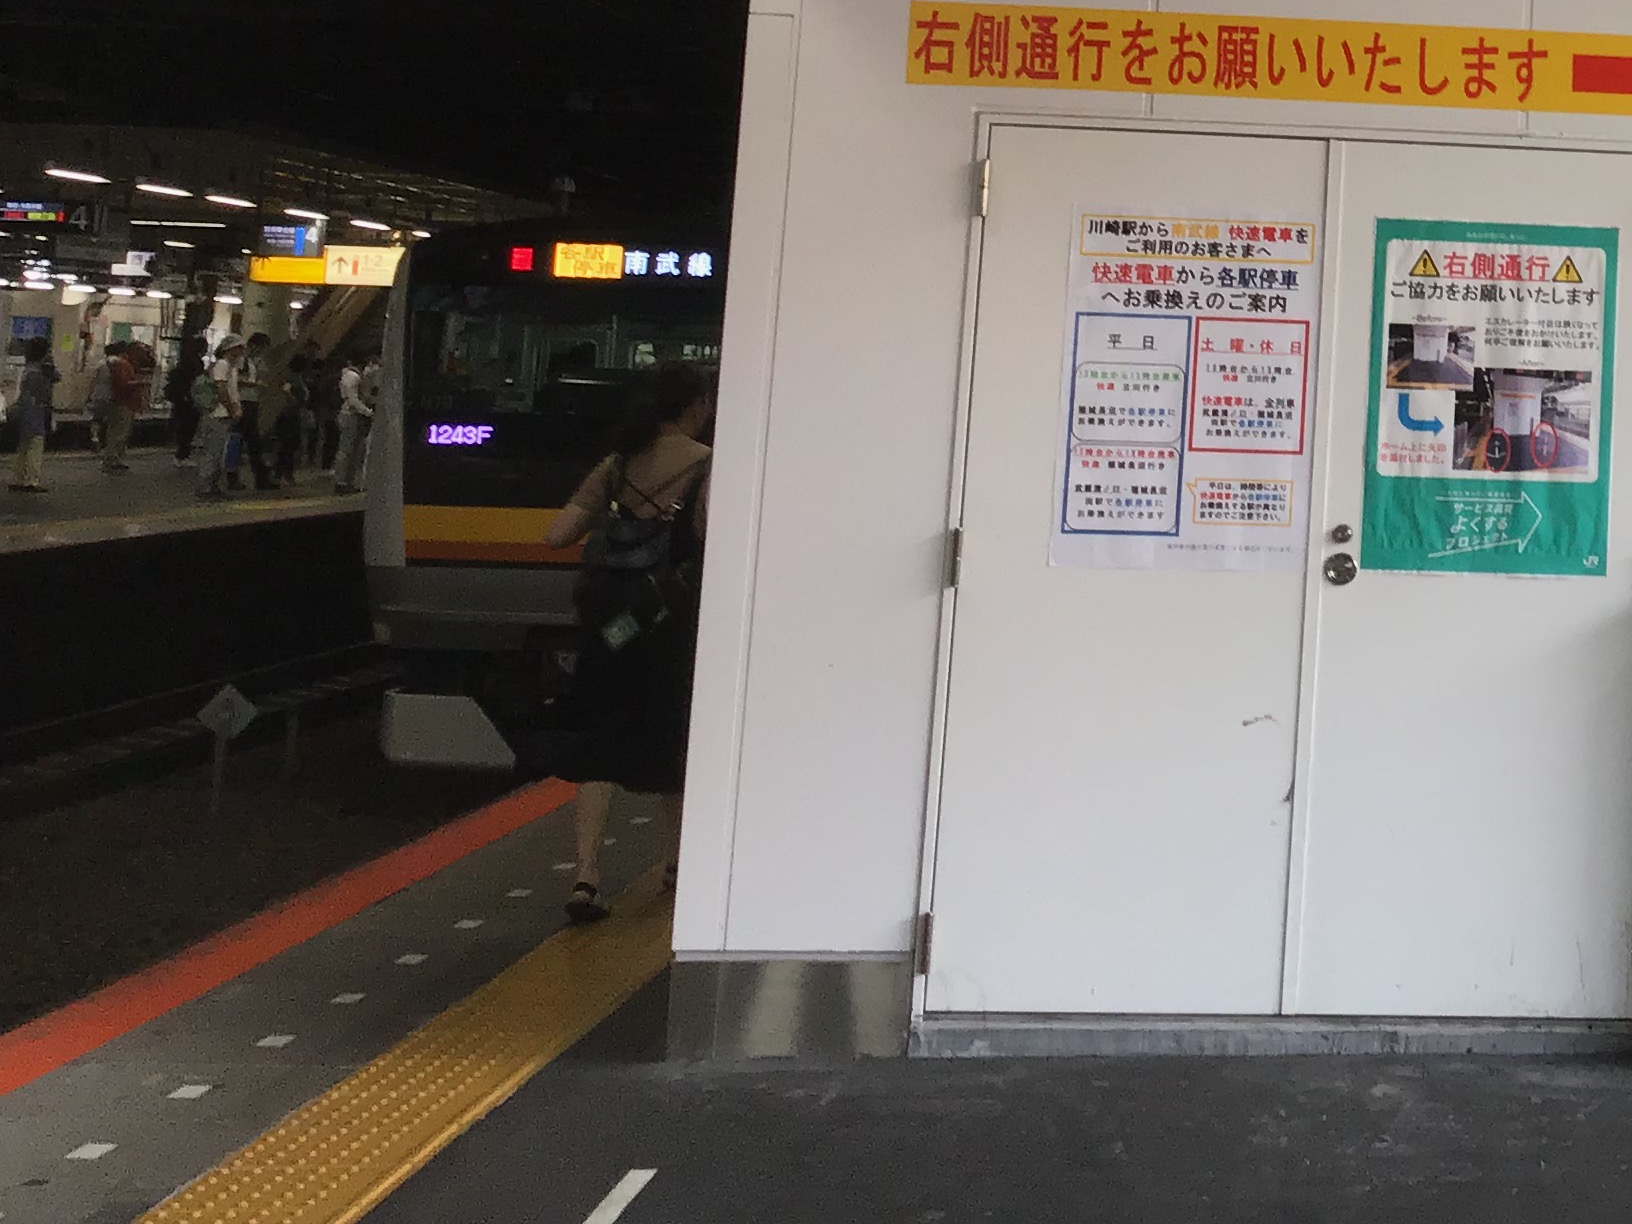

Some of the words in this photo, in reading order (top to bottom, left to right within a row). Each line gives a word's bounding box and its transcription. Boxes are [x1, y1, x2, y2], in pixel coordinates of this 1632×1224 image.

[914, 11, 1549, 102] 右側通行をお願いいたします
[1125, 238, 1272, 258] ご利用のお客さまへ
[623, 249, 714, 277] 南武線
[1091, 261, 1300, 290] 快速電車から各駅停車
[1442, 250, 1551, 282] 右側通行
[1100, 287, 1288, 314] へお乗換えのご案内
[1389, 280, 1601, 307] ご協力をお願いいたします
[426, 424, 495, 446] 1243F
